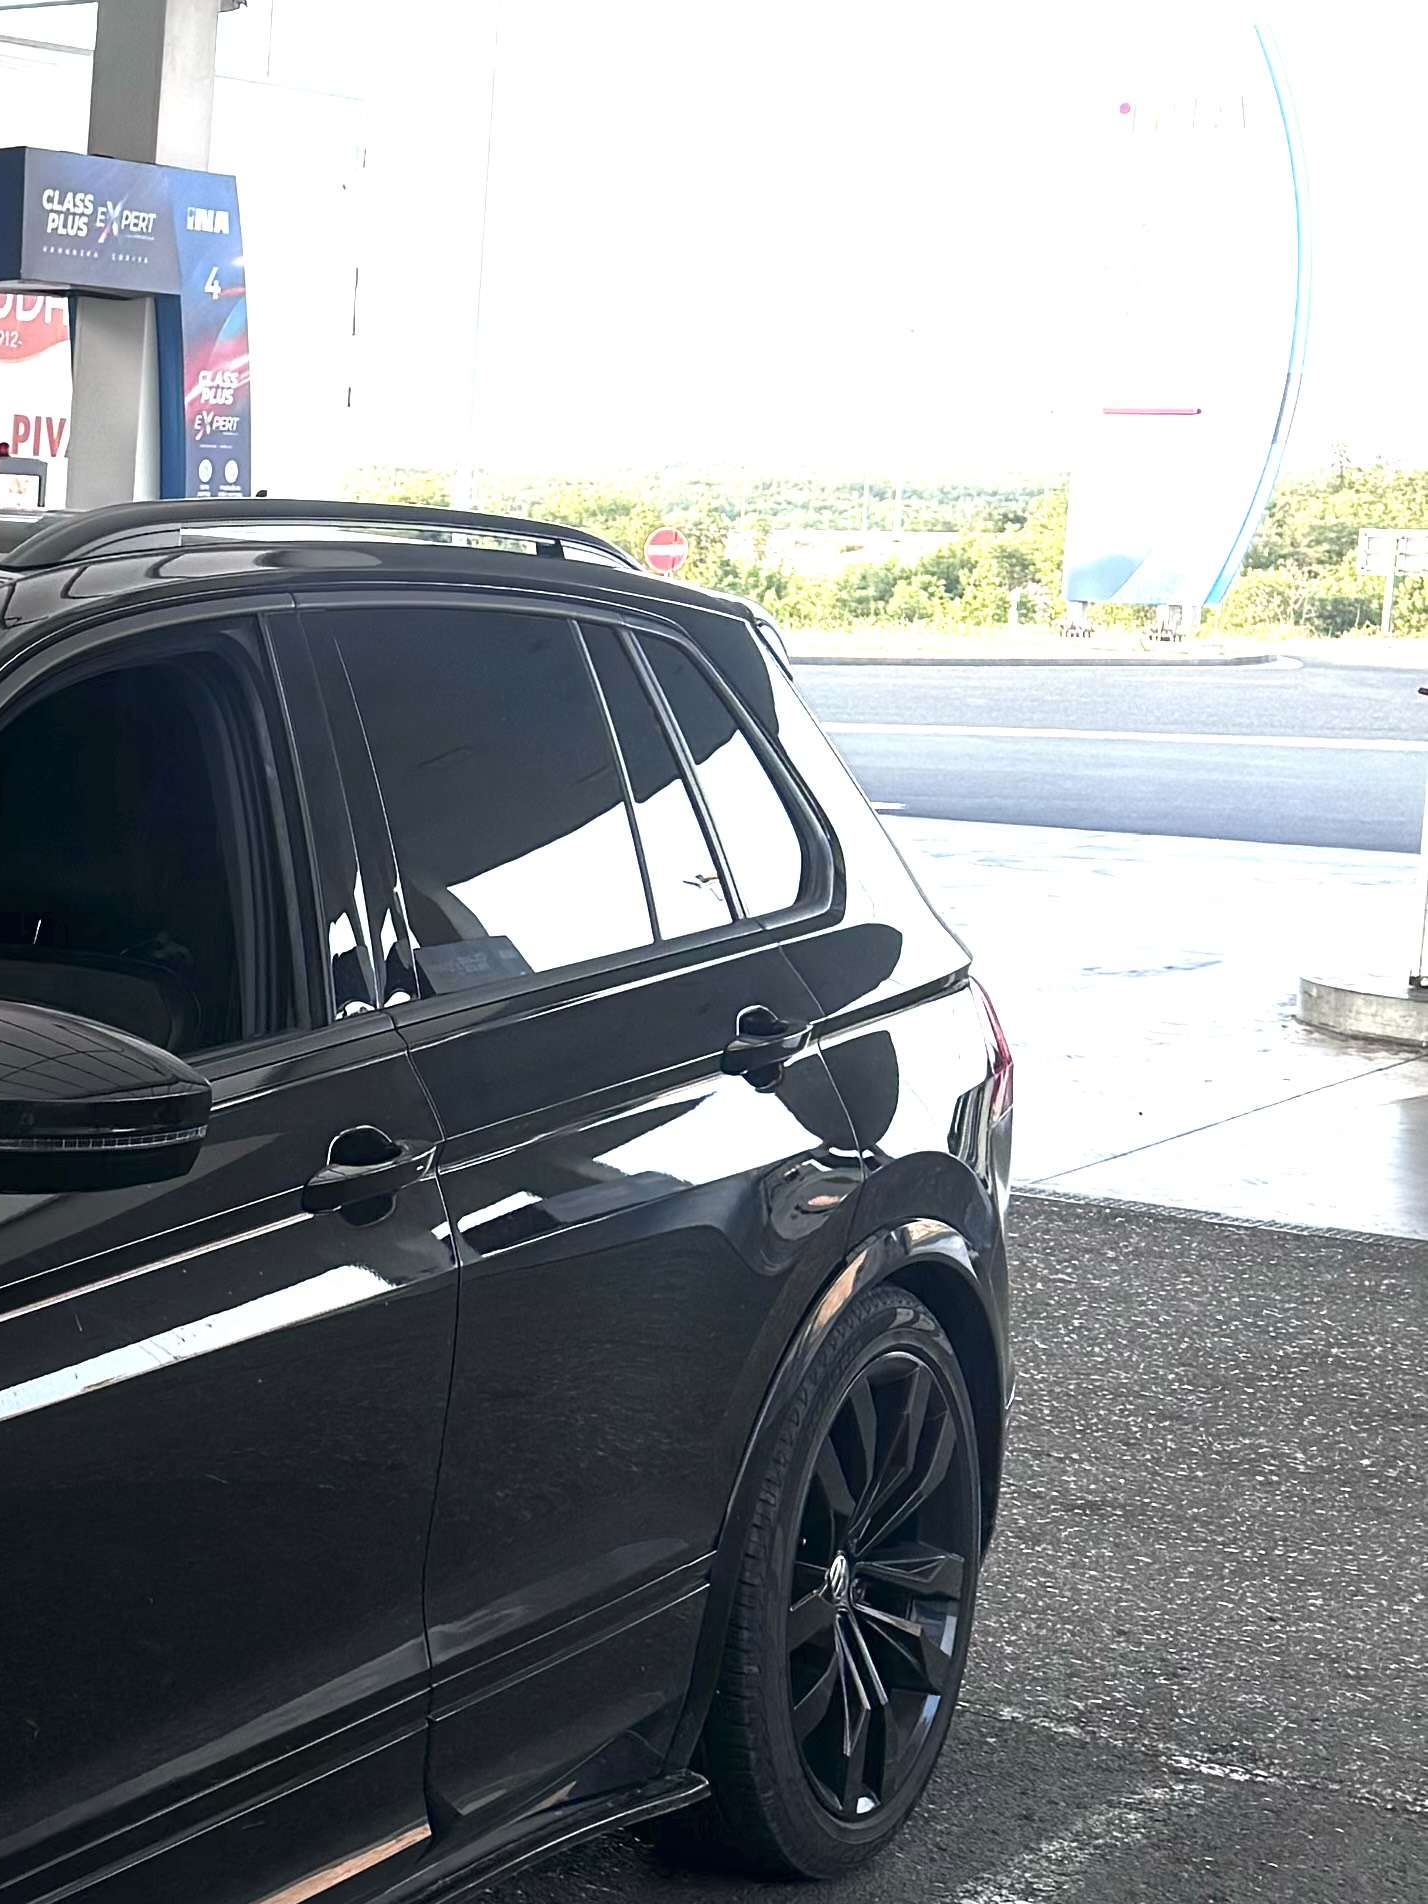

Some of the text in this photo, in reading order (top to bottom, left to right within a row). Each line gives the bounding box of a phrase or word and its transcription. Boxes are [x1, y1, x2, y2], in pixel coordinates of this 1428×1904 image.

[42, 188, 157, 243] CLASS EXPERT
[47, 212, 89, 237] PLUS
[204, 266, 222, 300] 4
[200, 388, 234, 405] PLUS
